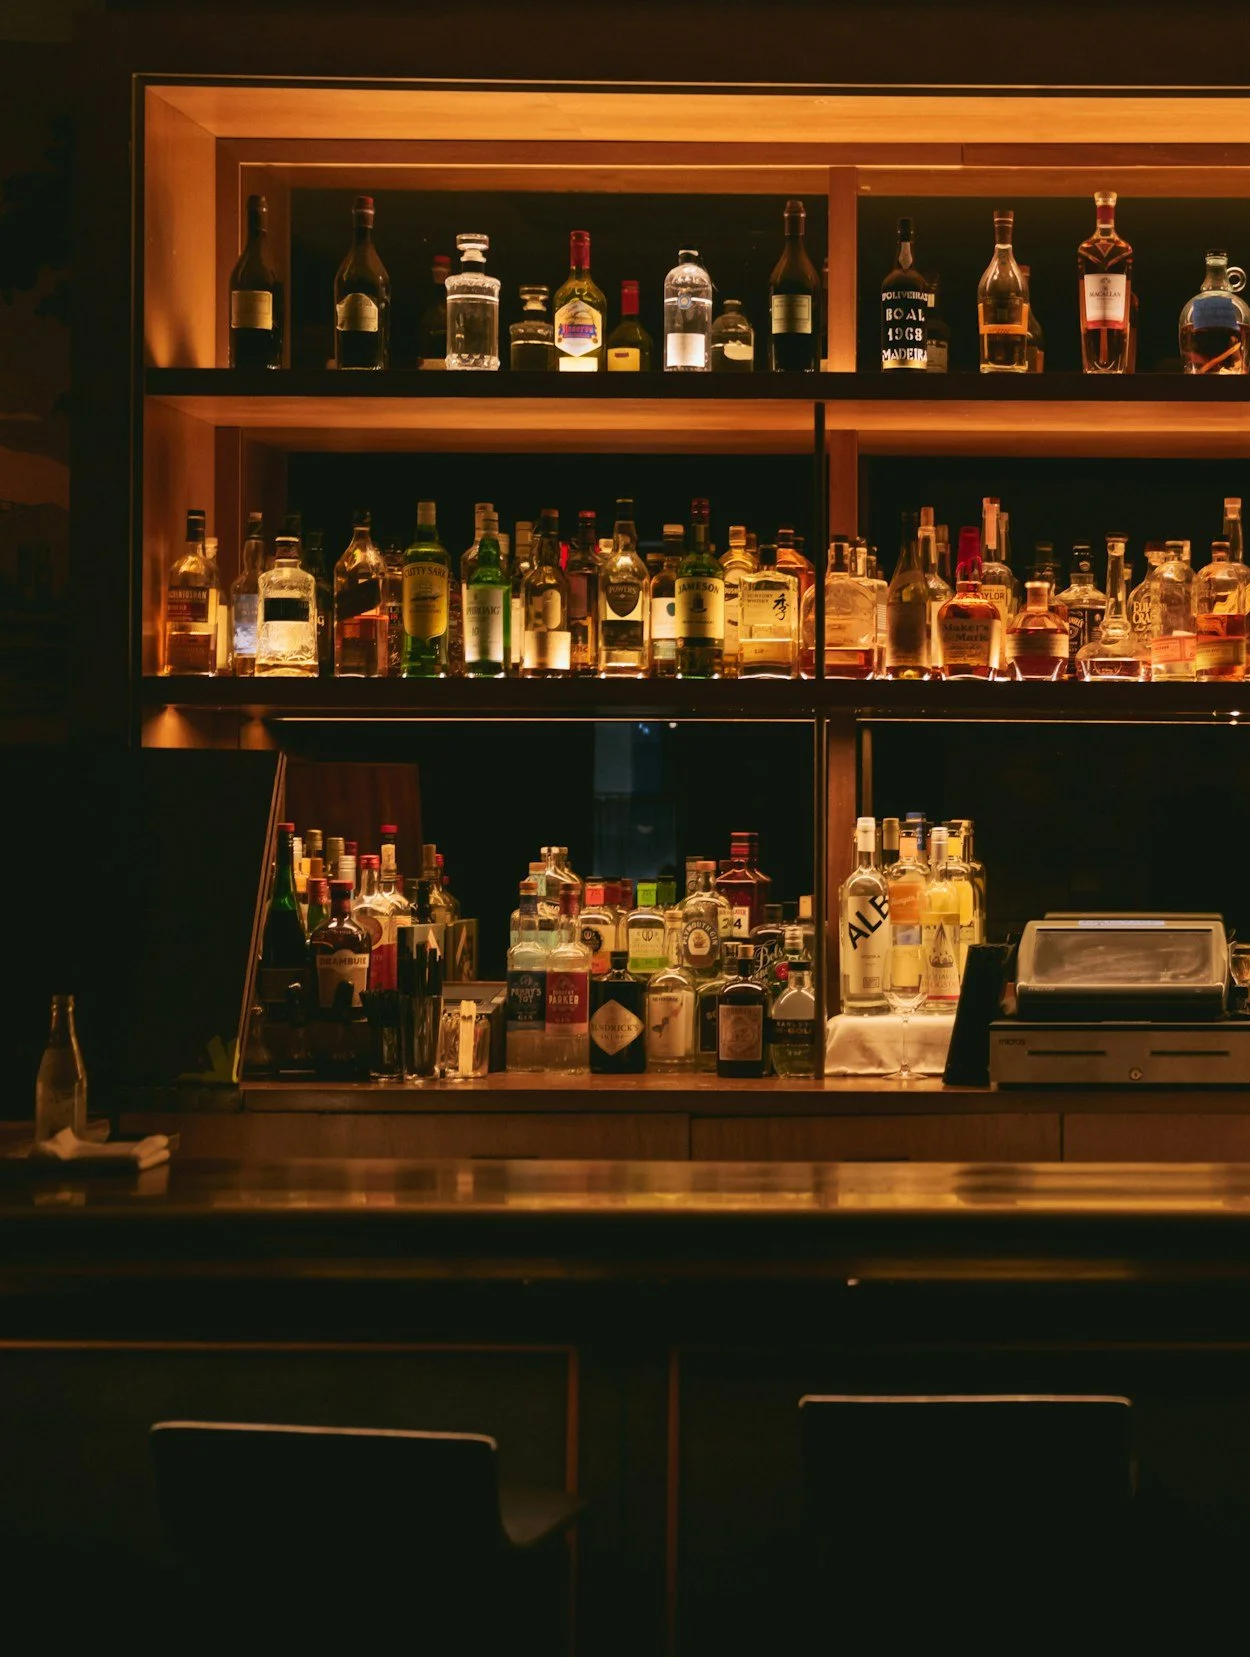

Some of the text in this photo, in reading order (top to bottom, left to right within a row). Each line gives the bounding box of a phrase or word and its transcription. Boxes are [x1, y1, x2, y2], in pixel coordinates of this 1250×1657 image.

[885, 308, 925, 321] BOAL
[887, 327, 923, 341] 1968
[882, 348, 928, 362] MADEIRA
[404, 565, 446, 578] CUTTY SARK
[608, 584, 637, 594] POWERS
[678, 583, 719, 594] JAMESON
[981, 592, 1005, 601] YLOR
[1132, 612, 1151, 624] CRA
[942, 623, 989, 632] Maker's
[956, 633, 989, 642] Mark
[683, 922, 719, 945] PLYMOUTH GIN
[319, 956, 367, 966] DRAMBUIE
[754, 940, 783, 973] Bols
[549, 995, 579, 1005] PARKER
